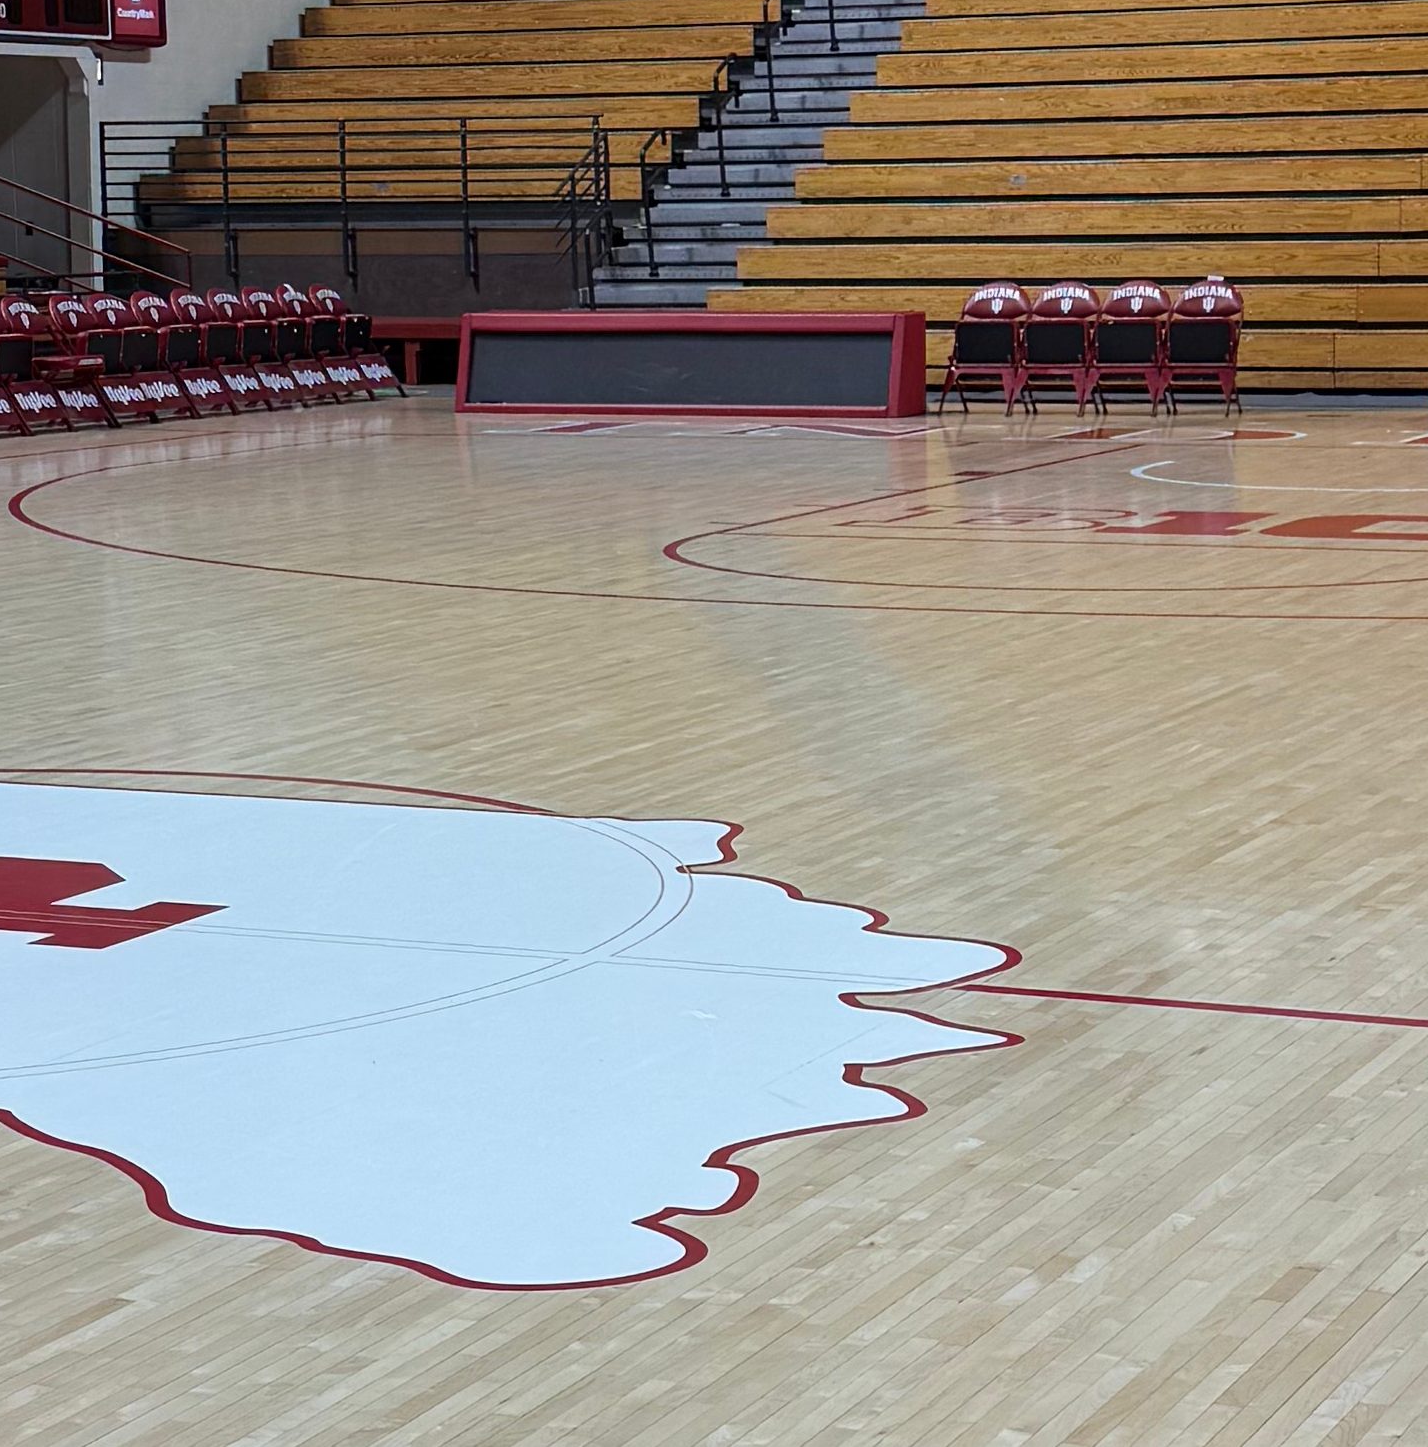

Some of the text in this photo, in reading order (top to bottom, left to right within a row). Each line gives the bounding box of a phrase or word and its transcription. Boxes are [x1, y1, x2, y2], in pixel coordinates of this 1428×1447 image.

[974, 286, 1021, 301] INDIANA
[1043, 286, 1090, 301] INDIANA
[1113, 285, 1161, 300] INDIANA
[1184, 285, 1233, 300] INDIANA
